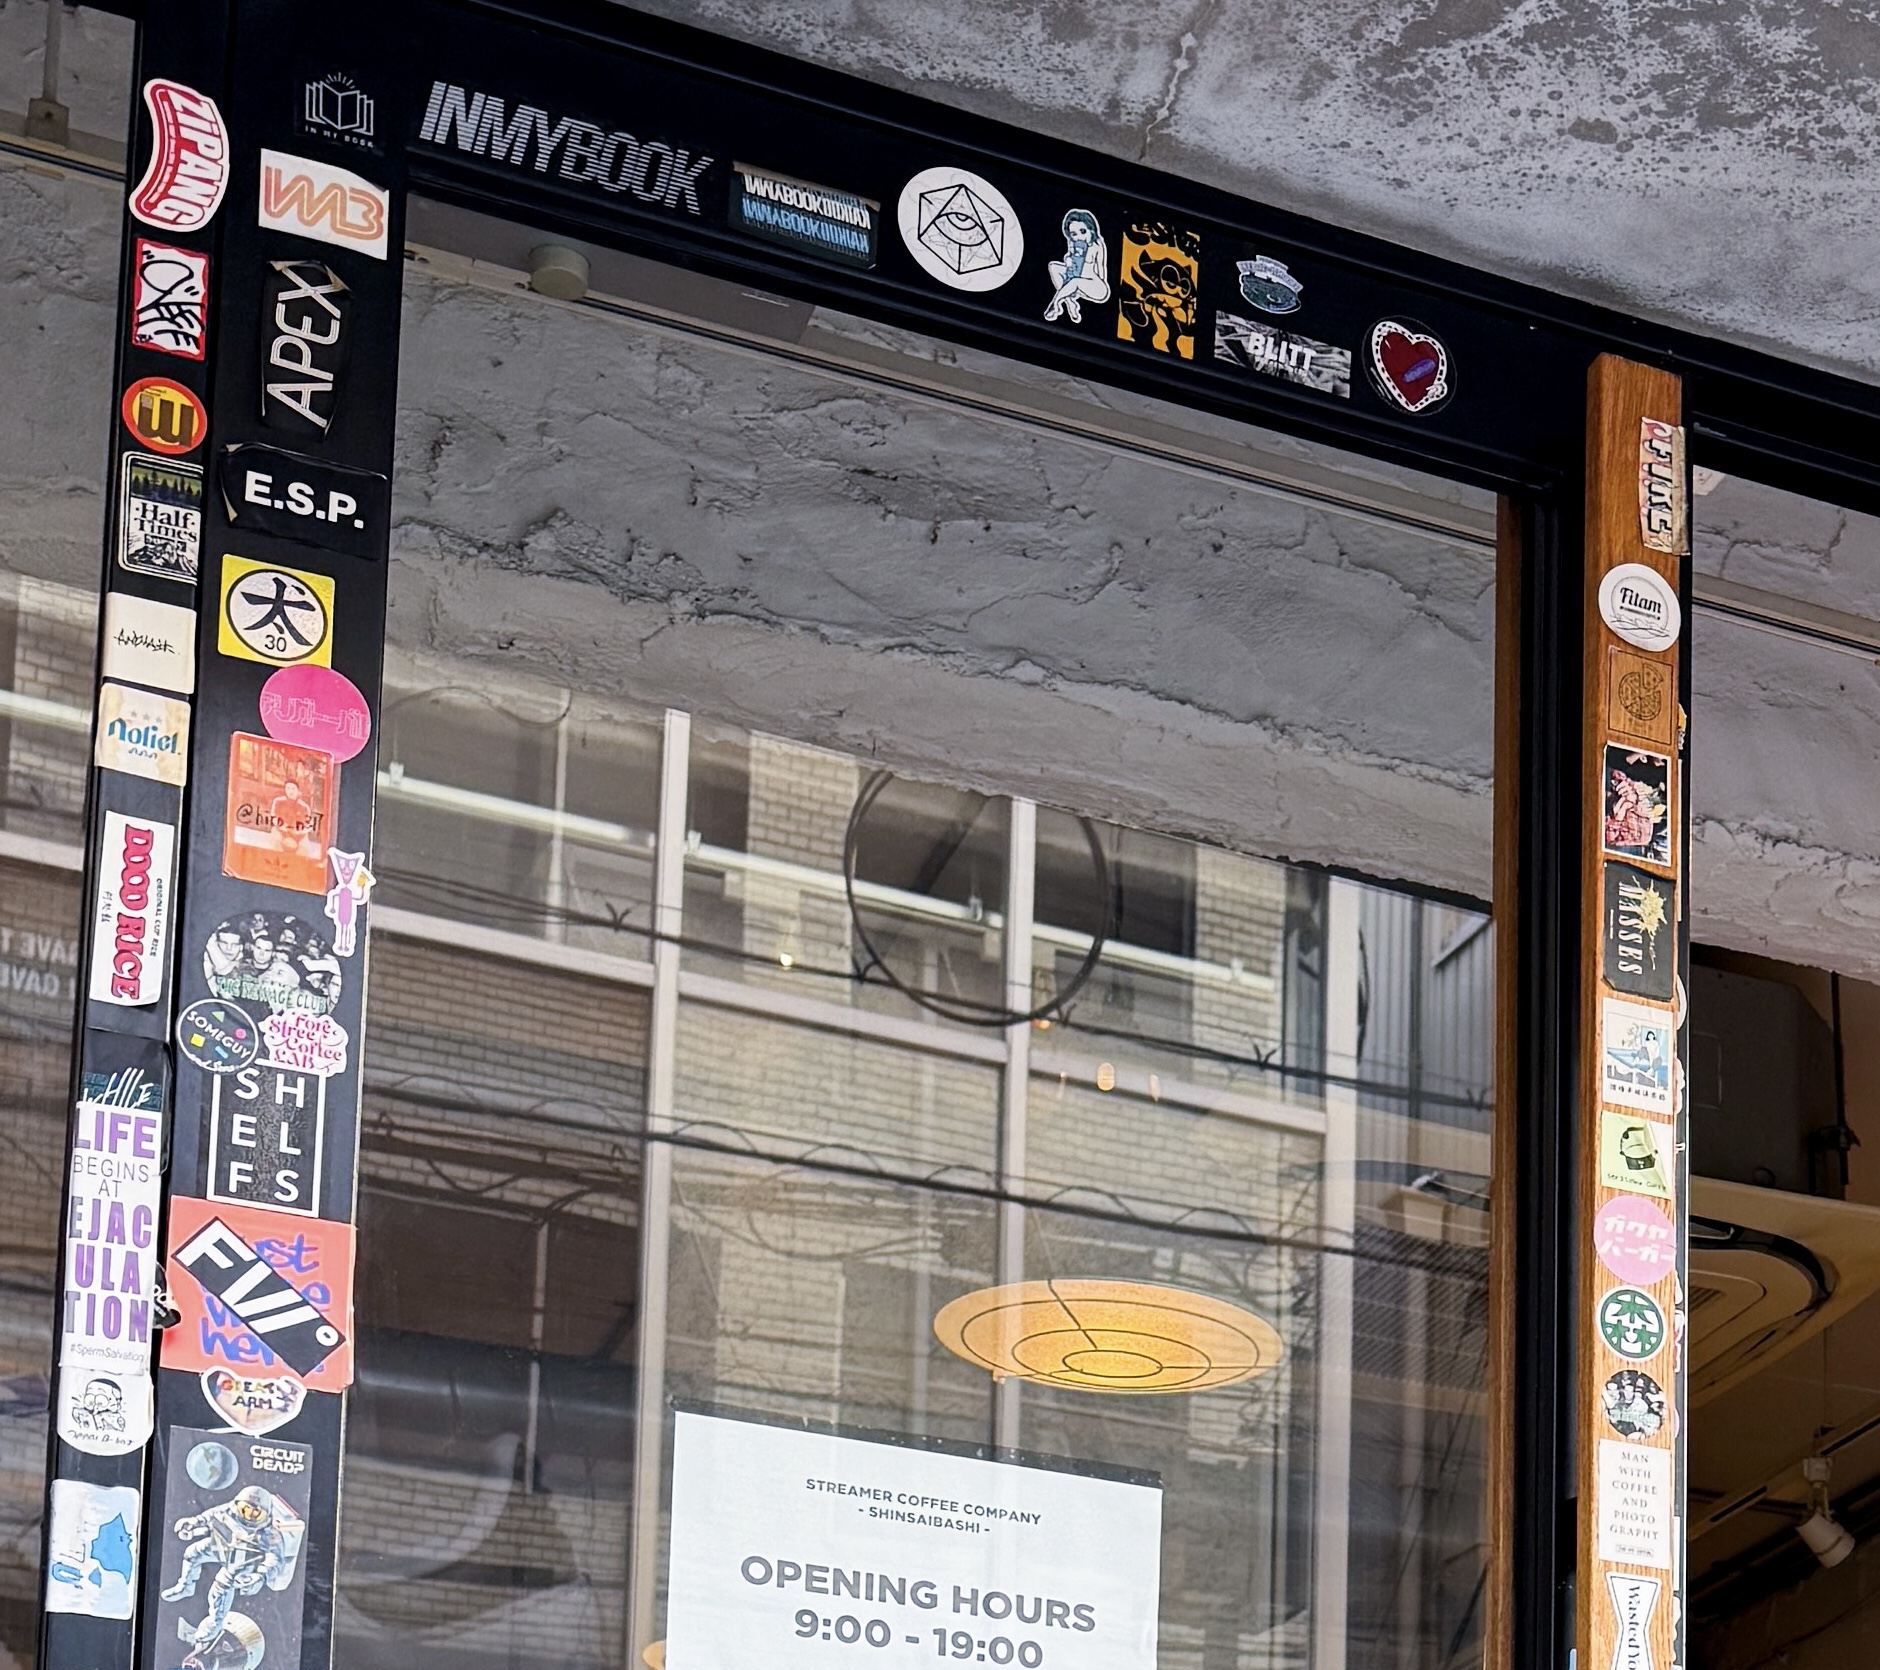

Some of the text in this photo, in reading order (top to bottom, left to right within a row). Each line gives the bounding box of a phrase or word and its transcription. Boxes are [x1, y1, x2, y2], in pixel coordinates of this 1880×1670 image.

[420, 81, 713, 214] INMYBOOK
[267, 265, 342, 429] APEX
[141, 502, 191, 529] Half
[244, 470, 365, 529] E.S.P.
[137, 519, 198, 543] Times
[264, 634, 287, 653] 30
[111, 915, 145, 1001] RICE
[187, 1010, 251, 1059] SOMEGUY
[75, 1108, 157, 1160] LIFE
[73, 1154, 149, 1183] BEGINS
[98, 1179, 122, 1198] AT
[69, 1195, 152, 1249] EJAC
[74, 1243, 141, 1295] ULA
[65, 1290, 148, 1343] TION
[250, 1444, 306, 1464] CIRCUIT
[1618, 1466, 1652, 1480] WITH
[1621, 1451, 1650, 1464] MAN
[805, 1478, 1043, 1527] STREAMER COFFEE COMPANY
[1612, 1480, 1658, 1495] COFFEE
[1622, 1497, 1648, 1509] AND
[868, 1506, 981, 1534] SHINSAIBASHI
[740, 1555, 1097, 1633] OPENING HOURS
[794, 1608, 892, 1649] 9:00
[932, 1627, 1045, 1670] 19:00
